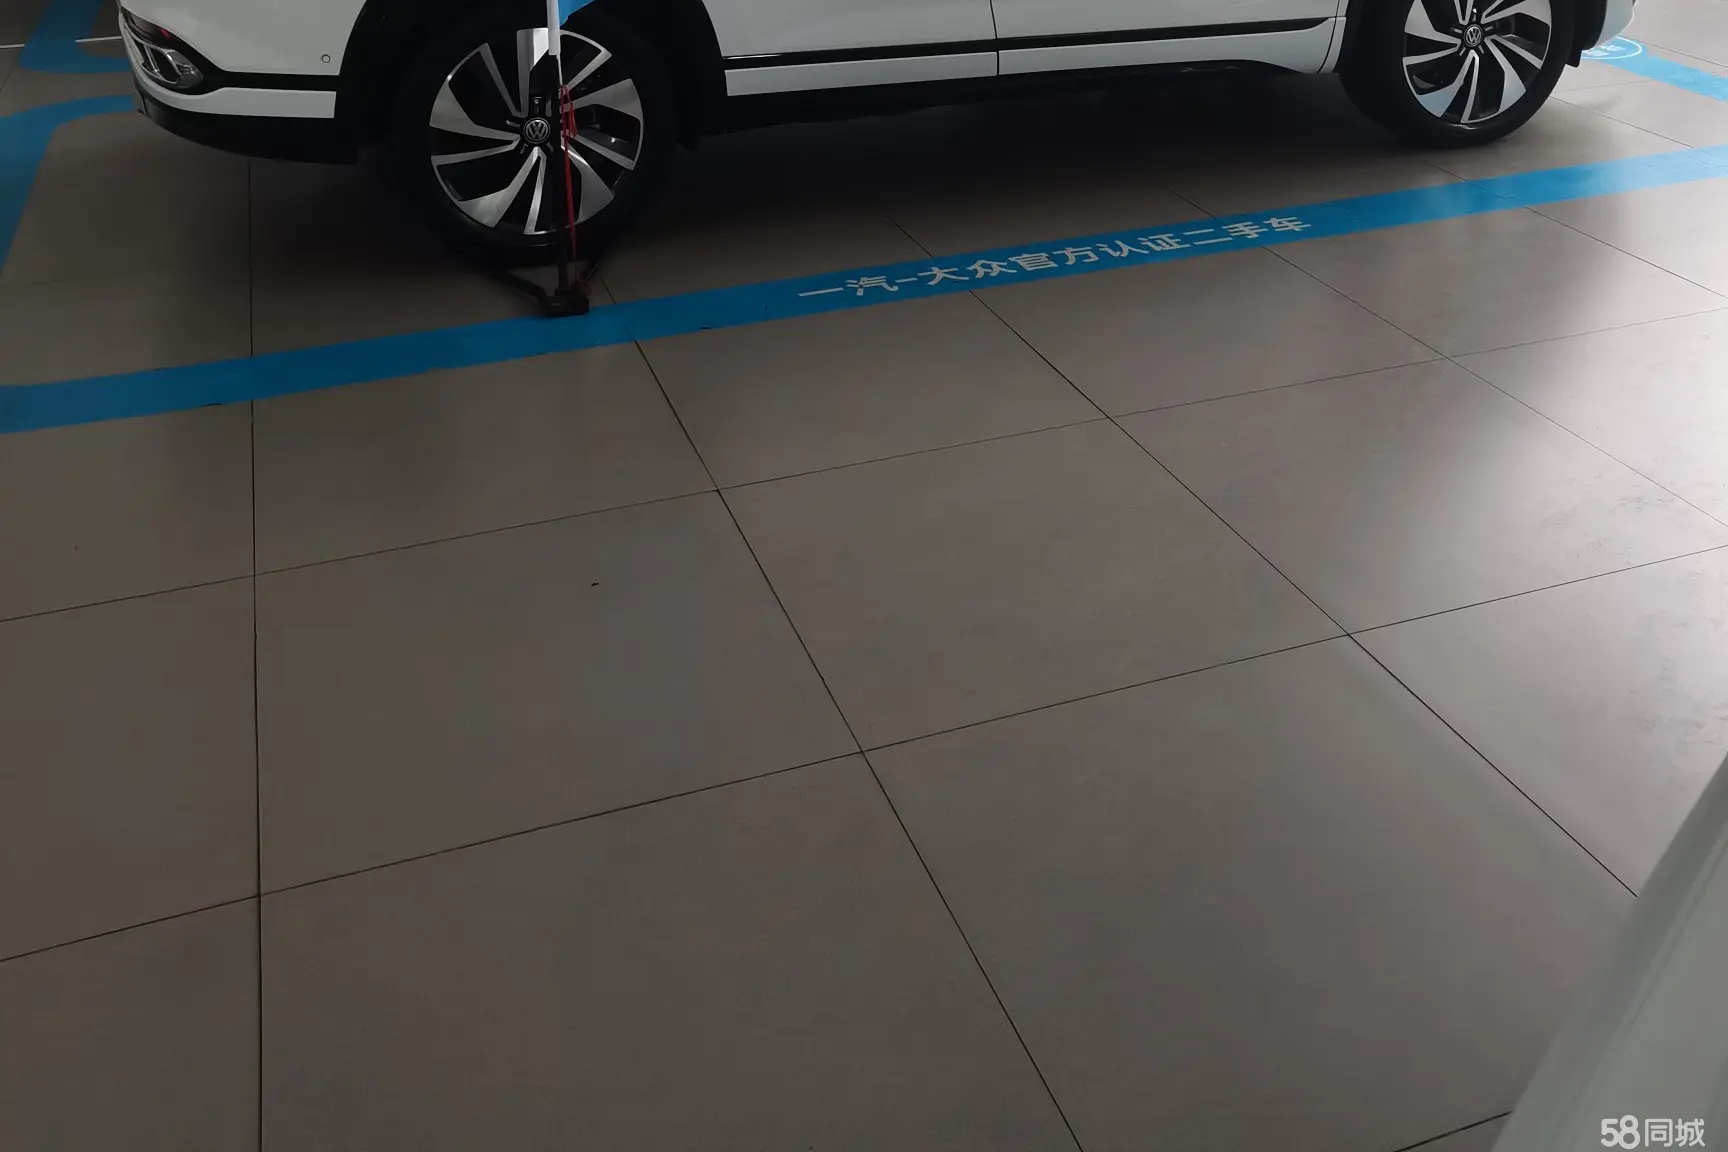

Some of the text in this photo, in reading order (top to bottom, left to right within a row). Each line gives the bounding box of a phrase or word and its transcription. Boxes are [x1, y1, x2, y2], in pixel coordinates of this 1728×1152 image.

[797, 216, 1312, 297] 一汽-大众官方认证二手车
